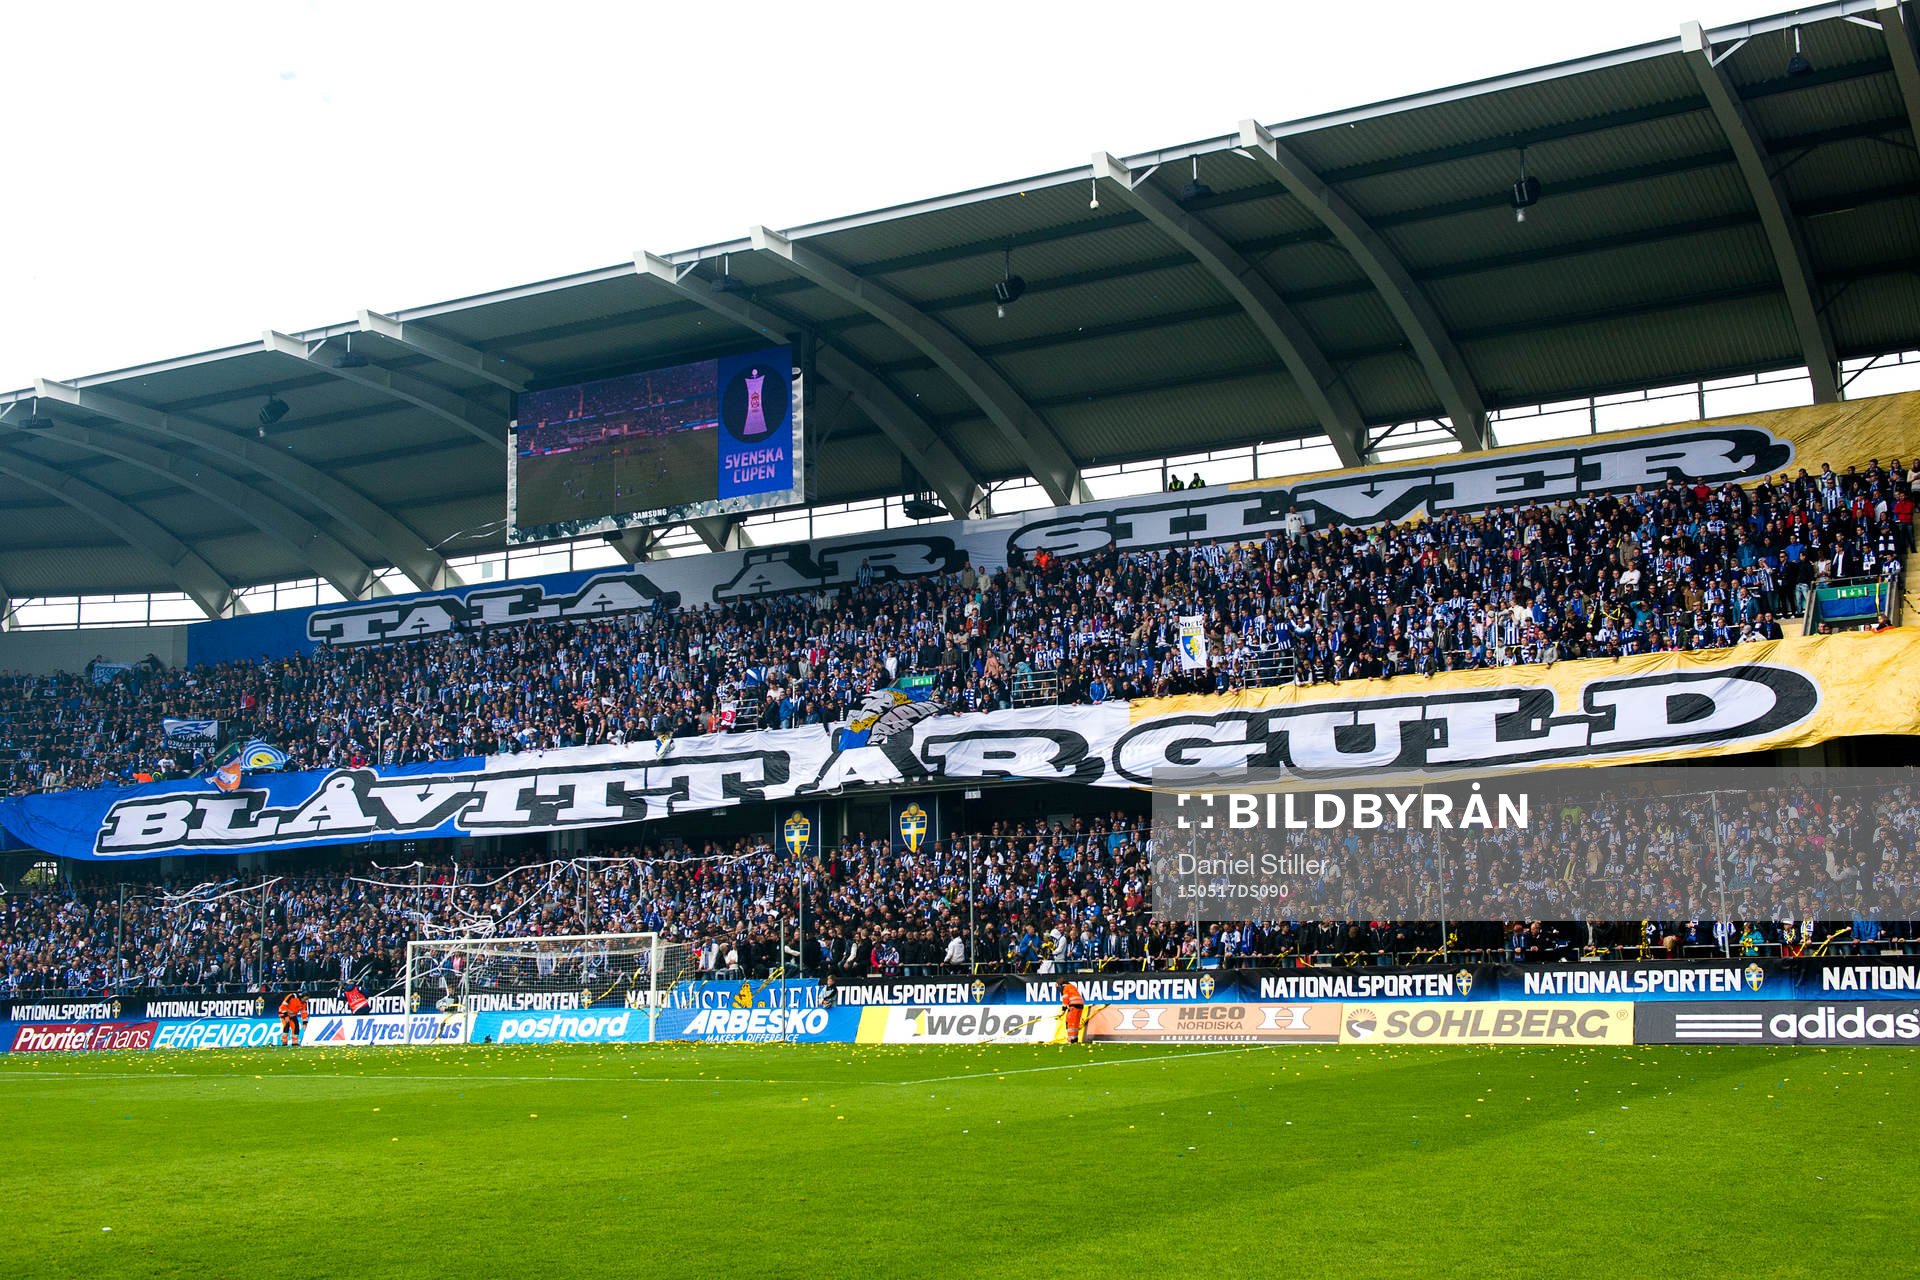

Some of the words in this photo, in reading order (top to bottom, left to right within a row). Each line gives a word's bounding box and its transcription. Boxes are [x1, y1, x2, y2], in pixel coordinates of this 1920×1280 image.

[725, 447, 784, 470] SVENSKA
[733, 465, 776, 484] CUPEN
[632, 508, 667, 521] SAMSUNG
[310, 576, 675, 644] TALA
[714, 541, 964, 601] ÄR
[1009, 427, 1790, 553] SILVER
[98, 750, 790, 854] BLÅVITT
[1112, 665, 1812, 780] GULD
[1260, 972, 1453, 998] NATIONALSPORTEN
[1524, 968, 1742, 994] NATIONALSPORTEN
[11, 1002, 111, 1021] NATIONALSPORTEN
[145, 999, 254, 1018] NATIONALSPORTEN
[682, 1008, 829, 1034] ARBESKO
[927, 1008, 1042, 1035] weber
[1178, 1006, 1246, 1020] HECO
[154, 1022, 283, 1047] EHRENBOR
[351, 1016, 462, 1044] Myresjöhus
[500, 1013, 630, 1039] postnord
[1177, 1021, 1243, 1030] NORDISKA
[1384, 1008, 1608, 1039] SOHLBERG
[1769, 1006, 1920, 1039] adidas
[15, 1027, 93, 1051] Prioritet
[97, 1024, 151, 1050] Finans
[705, 1034, 736, 1042] MAKES
